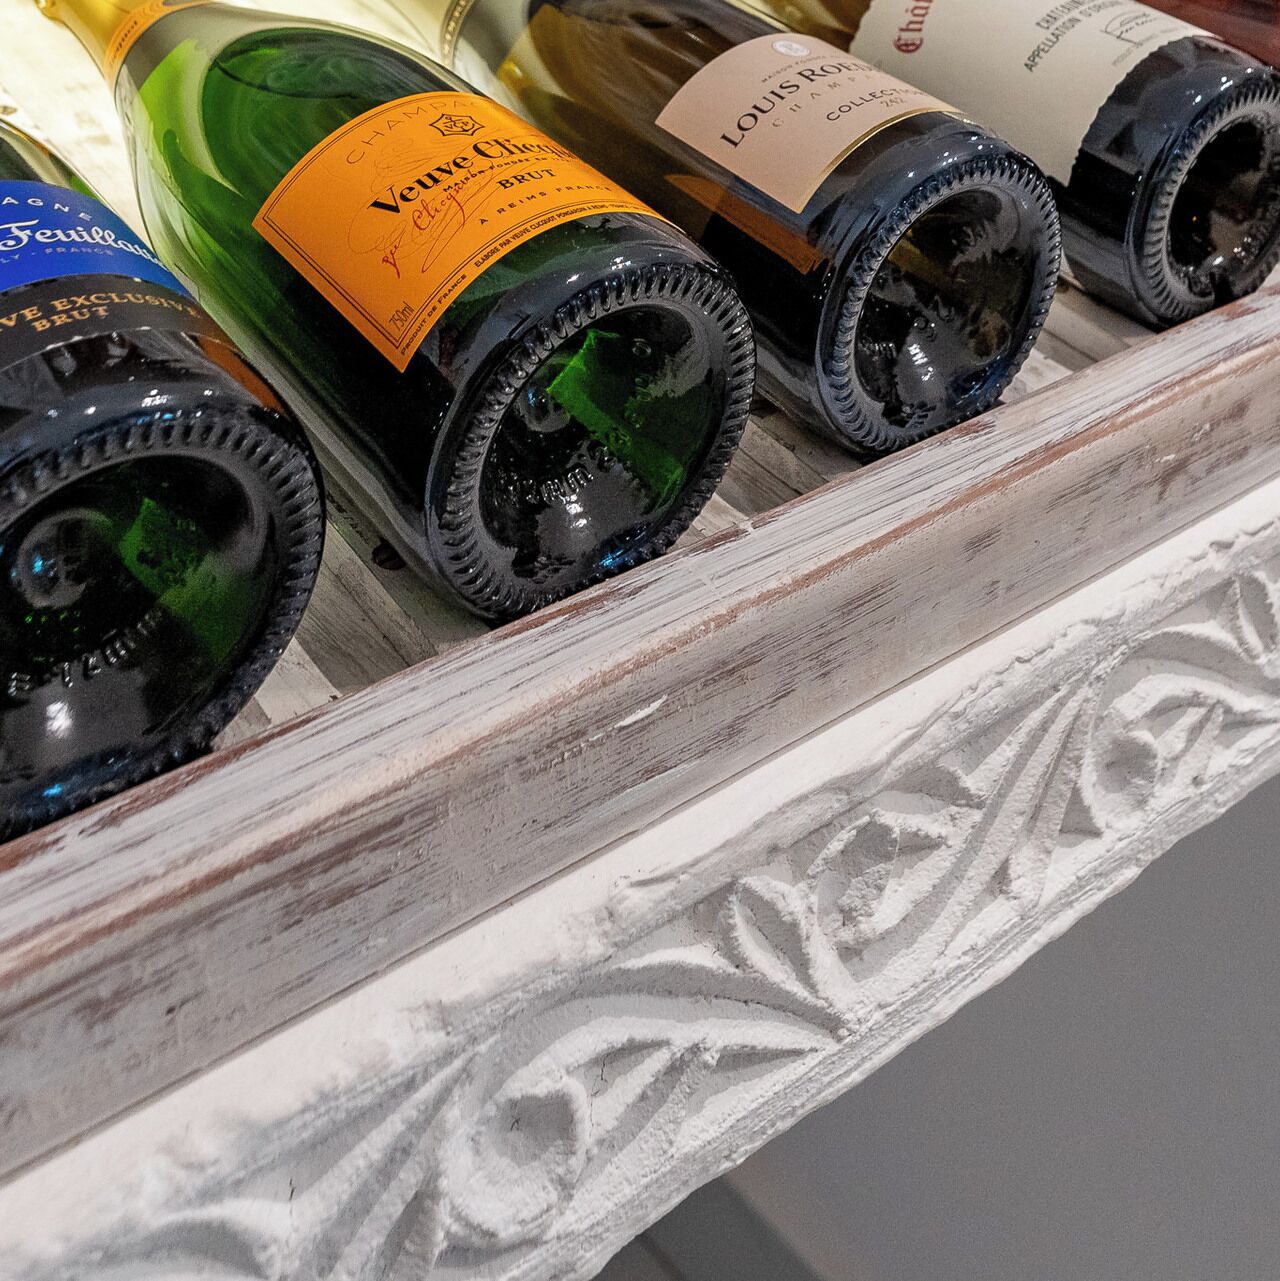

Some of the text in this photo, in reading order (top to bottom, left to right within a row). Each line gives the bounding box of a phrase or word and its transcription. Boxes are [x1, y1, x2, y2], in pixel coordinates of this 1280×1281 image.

[720, 79, 801, 149] LOUIS
[366, 153, 475, 215] Veuve
[497, 168, 557, 191] BRUT
[495, 190, 548, 216] REIMS
[555, 184, 612, 194] FRANCE
[500, 236, 514, 250] PAR
[511, 226, 533, 243] VEUVE
[529, 214, 558, 231] CLICQUOT
[45, 246, 116, 257] FRANCE
[30, 305, 109, 333] BRUT
[387, 300, 416, 333] 750ml
[399, 273, 468, 356] PRODUIT DE FRANCE
